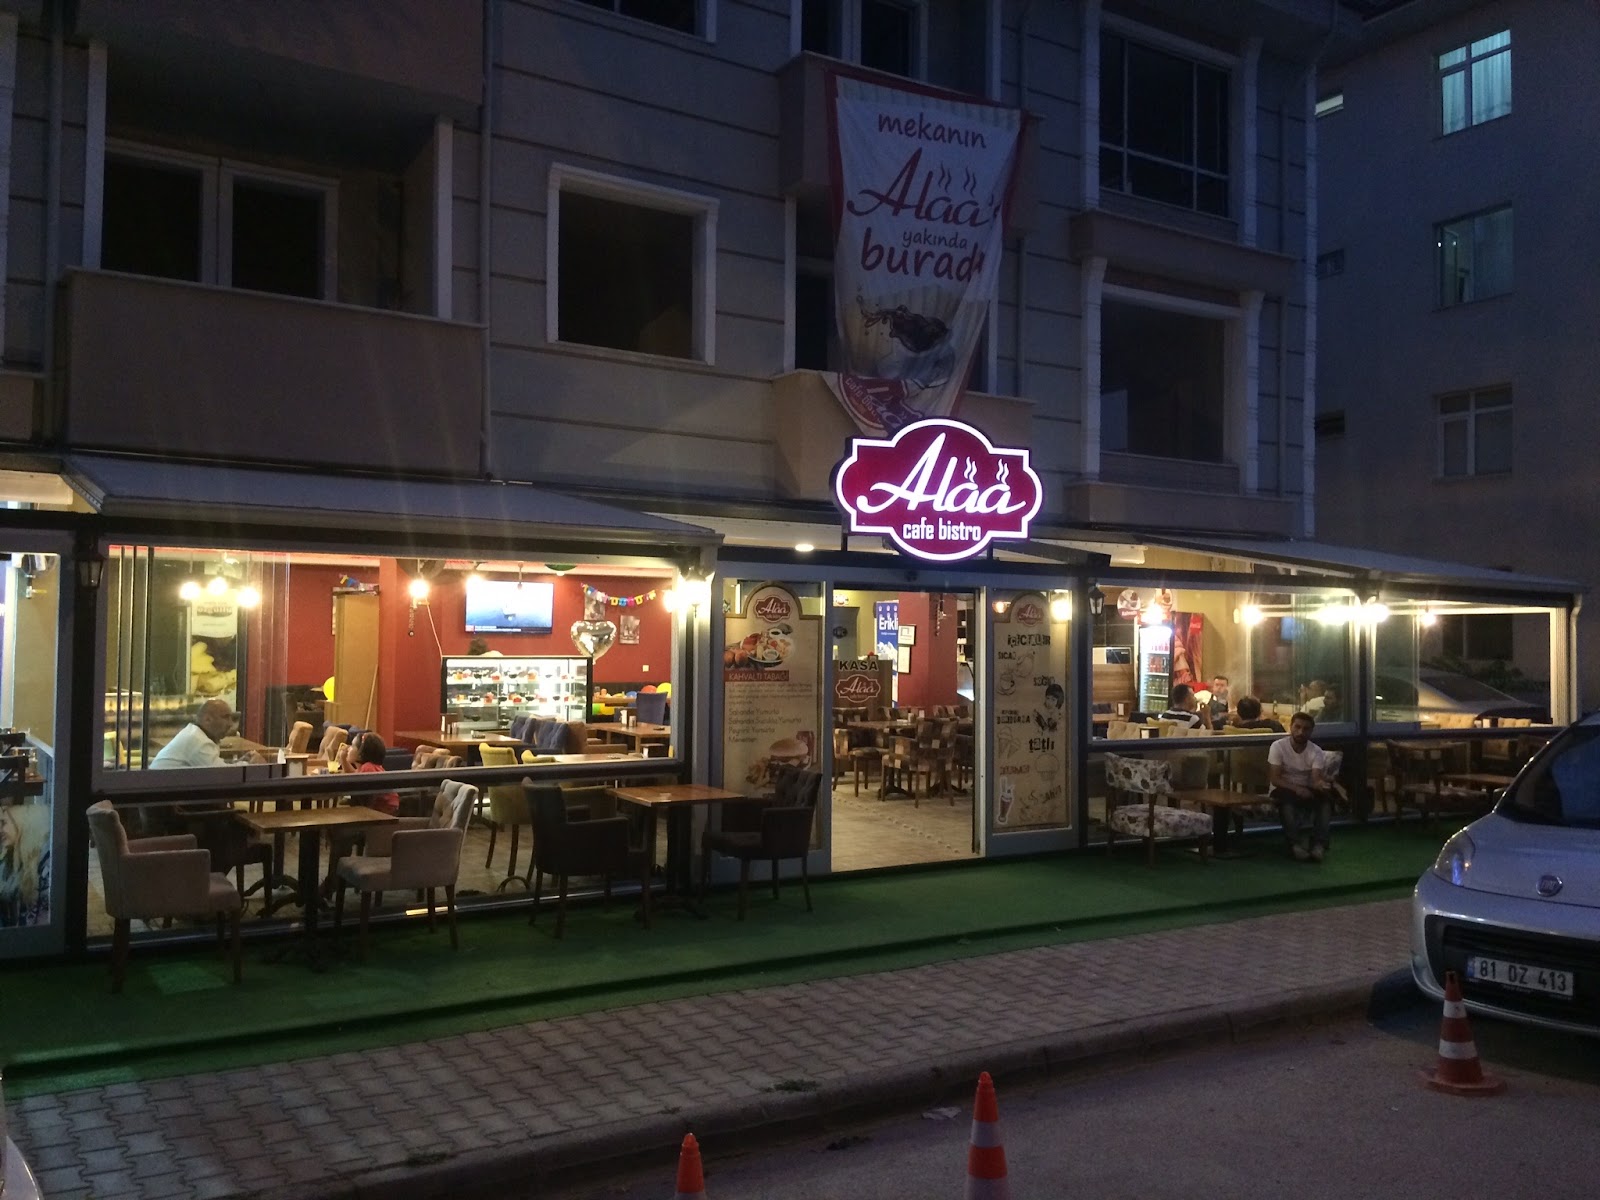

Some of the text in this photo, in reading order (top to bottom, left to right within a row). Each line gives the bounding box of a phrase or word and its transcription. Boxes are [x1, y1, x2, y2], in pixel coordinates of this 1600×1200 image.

[878, 111, 987, 149] mekanın
[903, 228, 967, 250] yakında
[902, 517, 982, 541] cafe bistro
[839, 660, 878, 671] KASA
[1480, 960, 1496, 980] 81
[1508, 964, 1529, 985] DZ
[1538, 971, 1567, 992] 413
